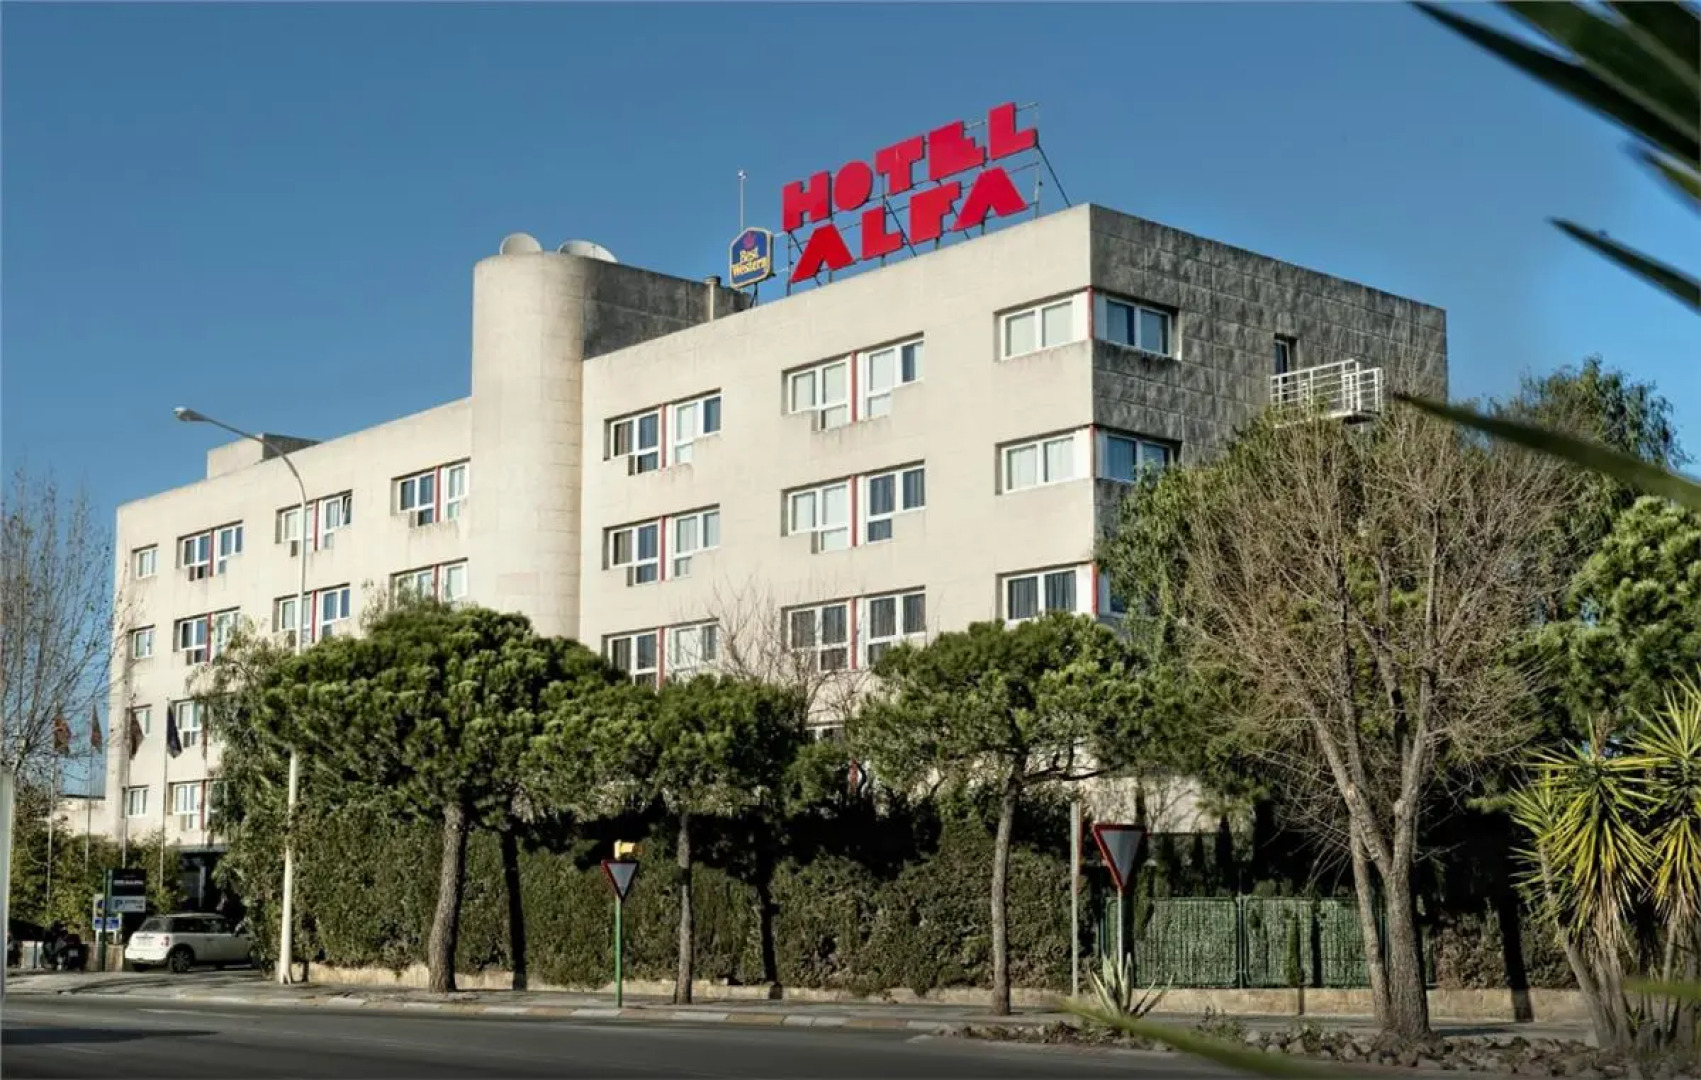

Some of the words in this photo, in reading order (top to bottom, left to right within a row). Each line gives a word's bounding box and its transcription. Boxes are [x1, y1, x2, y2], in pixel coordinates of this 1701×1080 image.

[782, 102, 1037, 232] HOTEL
[740, 247, 759, 264] Best
[790, 166, 1028, 283] ALFA
[731, 257, 769, 276] Western
